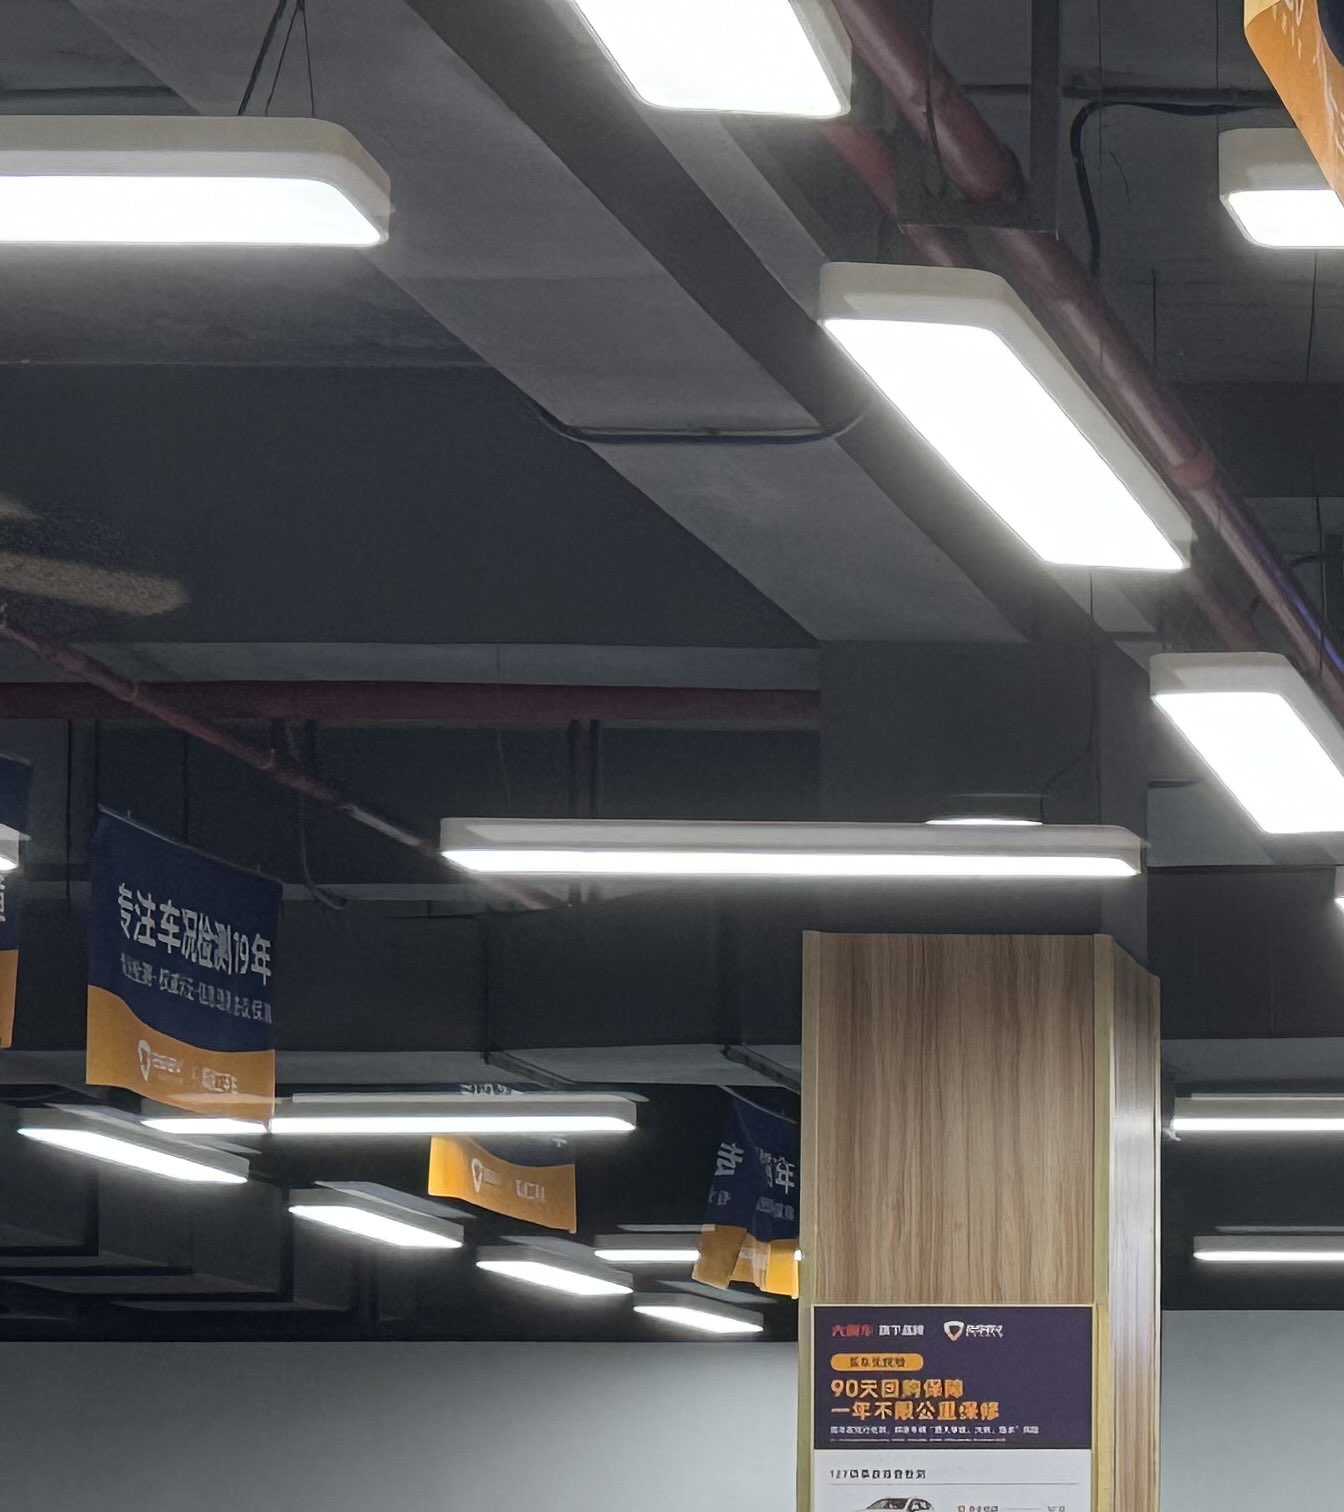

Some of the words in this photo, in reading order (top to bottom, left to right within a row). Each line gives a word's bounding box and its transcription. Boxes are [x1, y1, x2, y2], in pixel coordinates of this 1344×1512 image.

[117, 882, 273, 987] 专注车况检测19年
[830, 1378, 964, 1400] 90天回购保障
